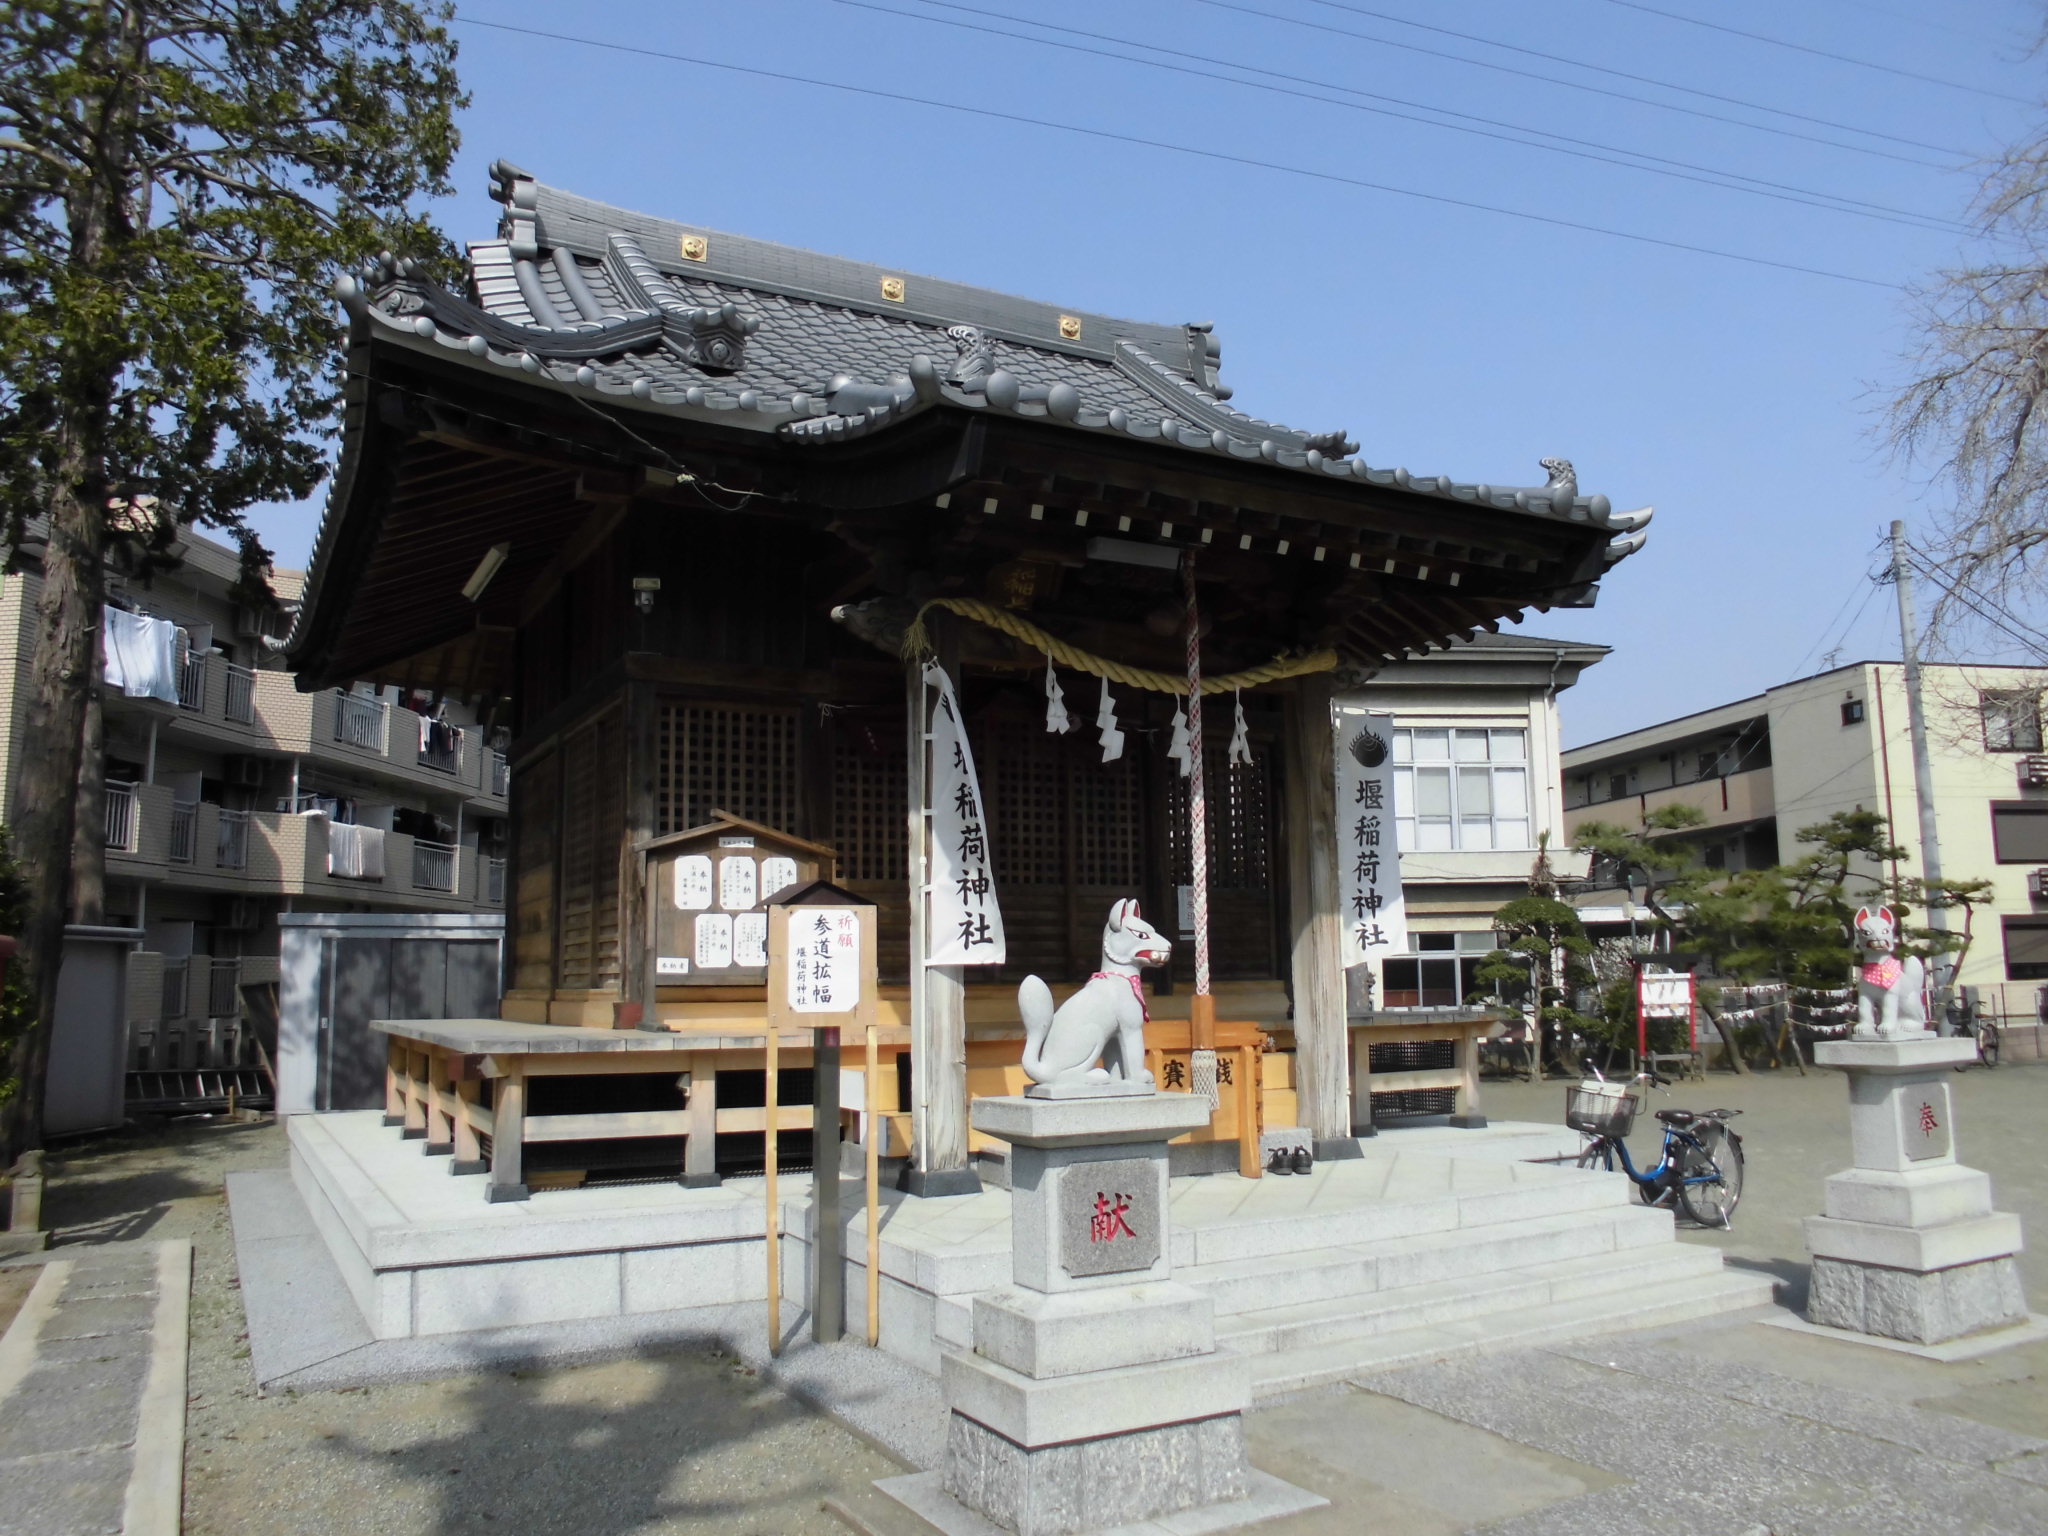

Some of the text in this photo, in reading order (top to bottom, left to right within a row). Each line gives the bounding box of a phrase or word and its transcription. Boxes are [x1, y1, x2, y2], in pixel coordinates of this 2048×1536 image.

[1352, 779, 1389, 951] 堰稲荷神社
[812, 913, 833, 1004] 参道拡幅
[838, 914, 854, 948] 祈願
[796, 947, 808, 1006] 堰稲荷神社
[1919, 1101, 1939, 1139] 奉
[1090, 1191, 1137, 1244] 献
